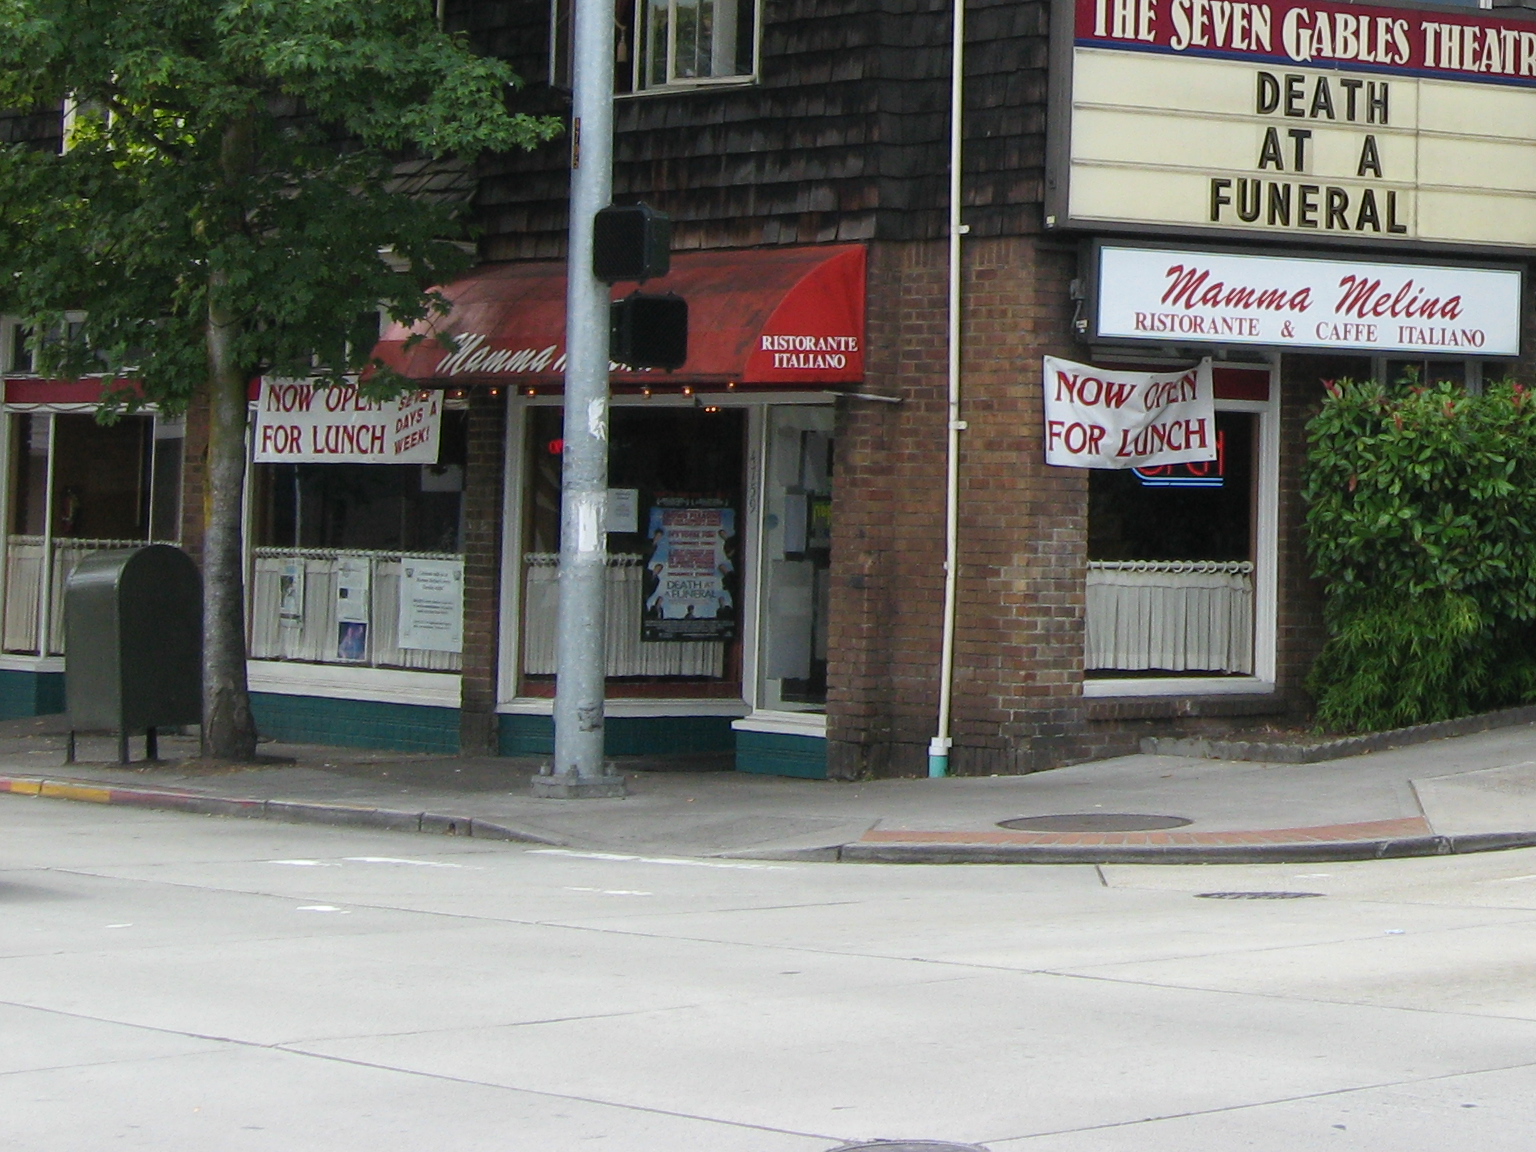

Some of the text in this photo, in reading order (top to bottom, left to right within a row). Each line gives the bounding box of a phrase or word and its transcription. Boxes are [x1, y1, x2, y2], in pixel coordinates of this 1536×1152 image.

[1282, 7, 1411, 62] GABLES
[1256, 71, 1389, 125] DEATH
[1258, 127, 1382, 178] AT A
[1210, 177, 1407, 234] FUNERAL
[1161, 264, 1463, 321] Mamma Melina
[761, 335, 858, 351] RISTORANTE
[1134, 312, 1485, 348] RISTORANTE & CAFFE ITALIANO
[435, 332, 557, 377] Mamma
[773, 353, 846, 369] ITALIANO
[266, 384, 317, 412] NOW
[1055, 371, 1137, 409] NOW
[395, 400, 437, 434] DAYS A
[261, 425, 386, 454] FOR LUNCH
[394, 426, 430, 455] WEEK!
[1048, 420, 1106, 457] FOR
[1115, 418, 1207, 457] LUNCH
[667, 580, 702, 590] DEATH
